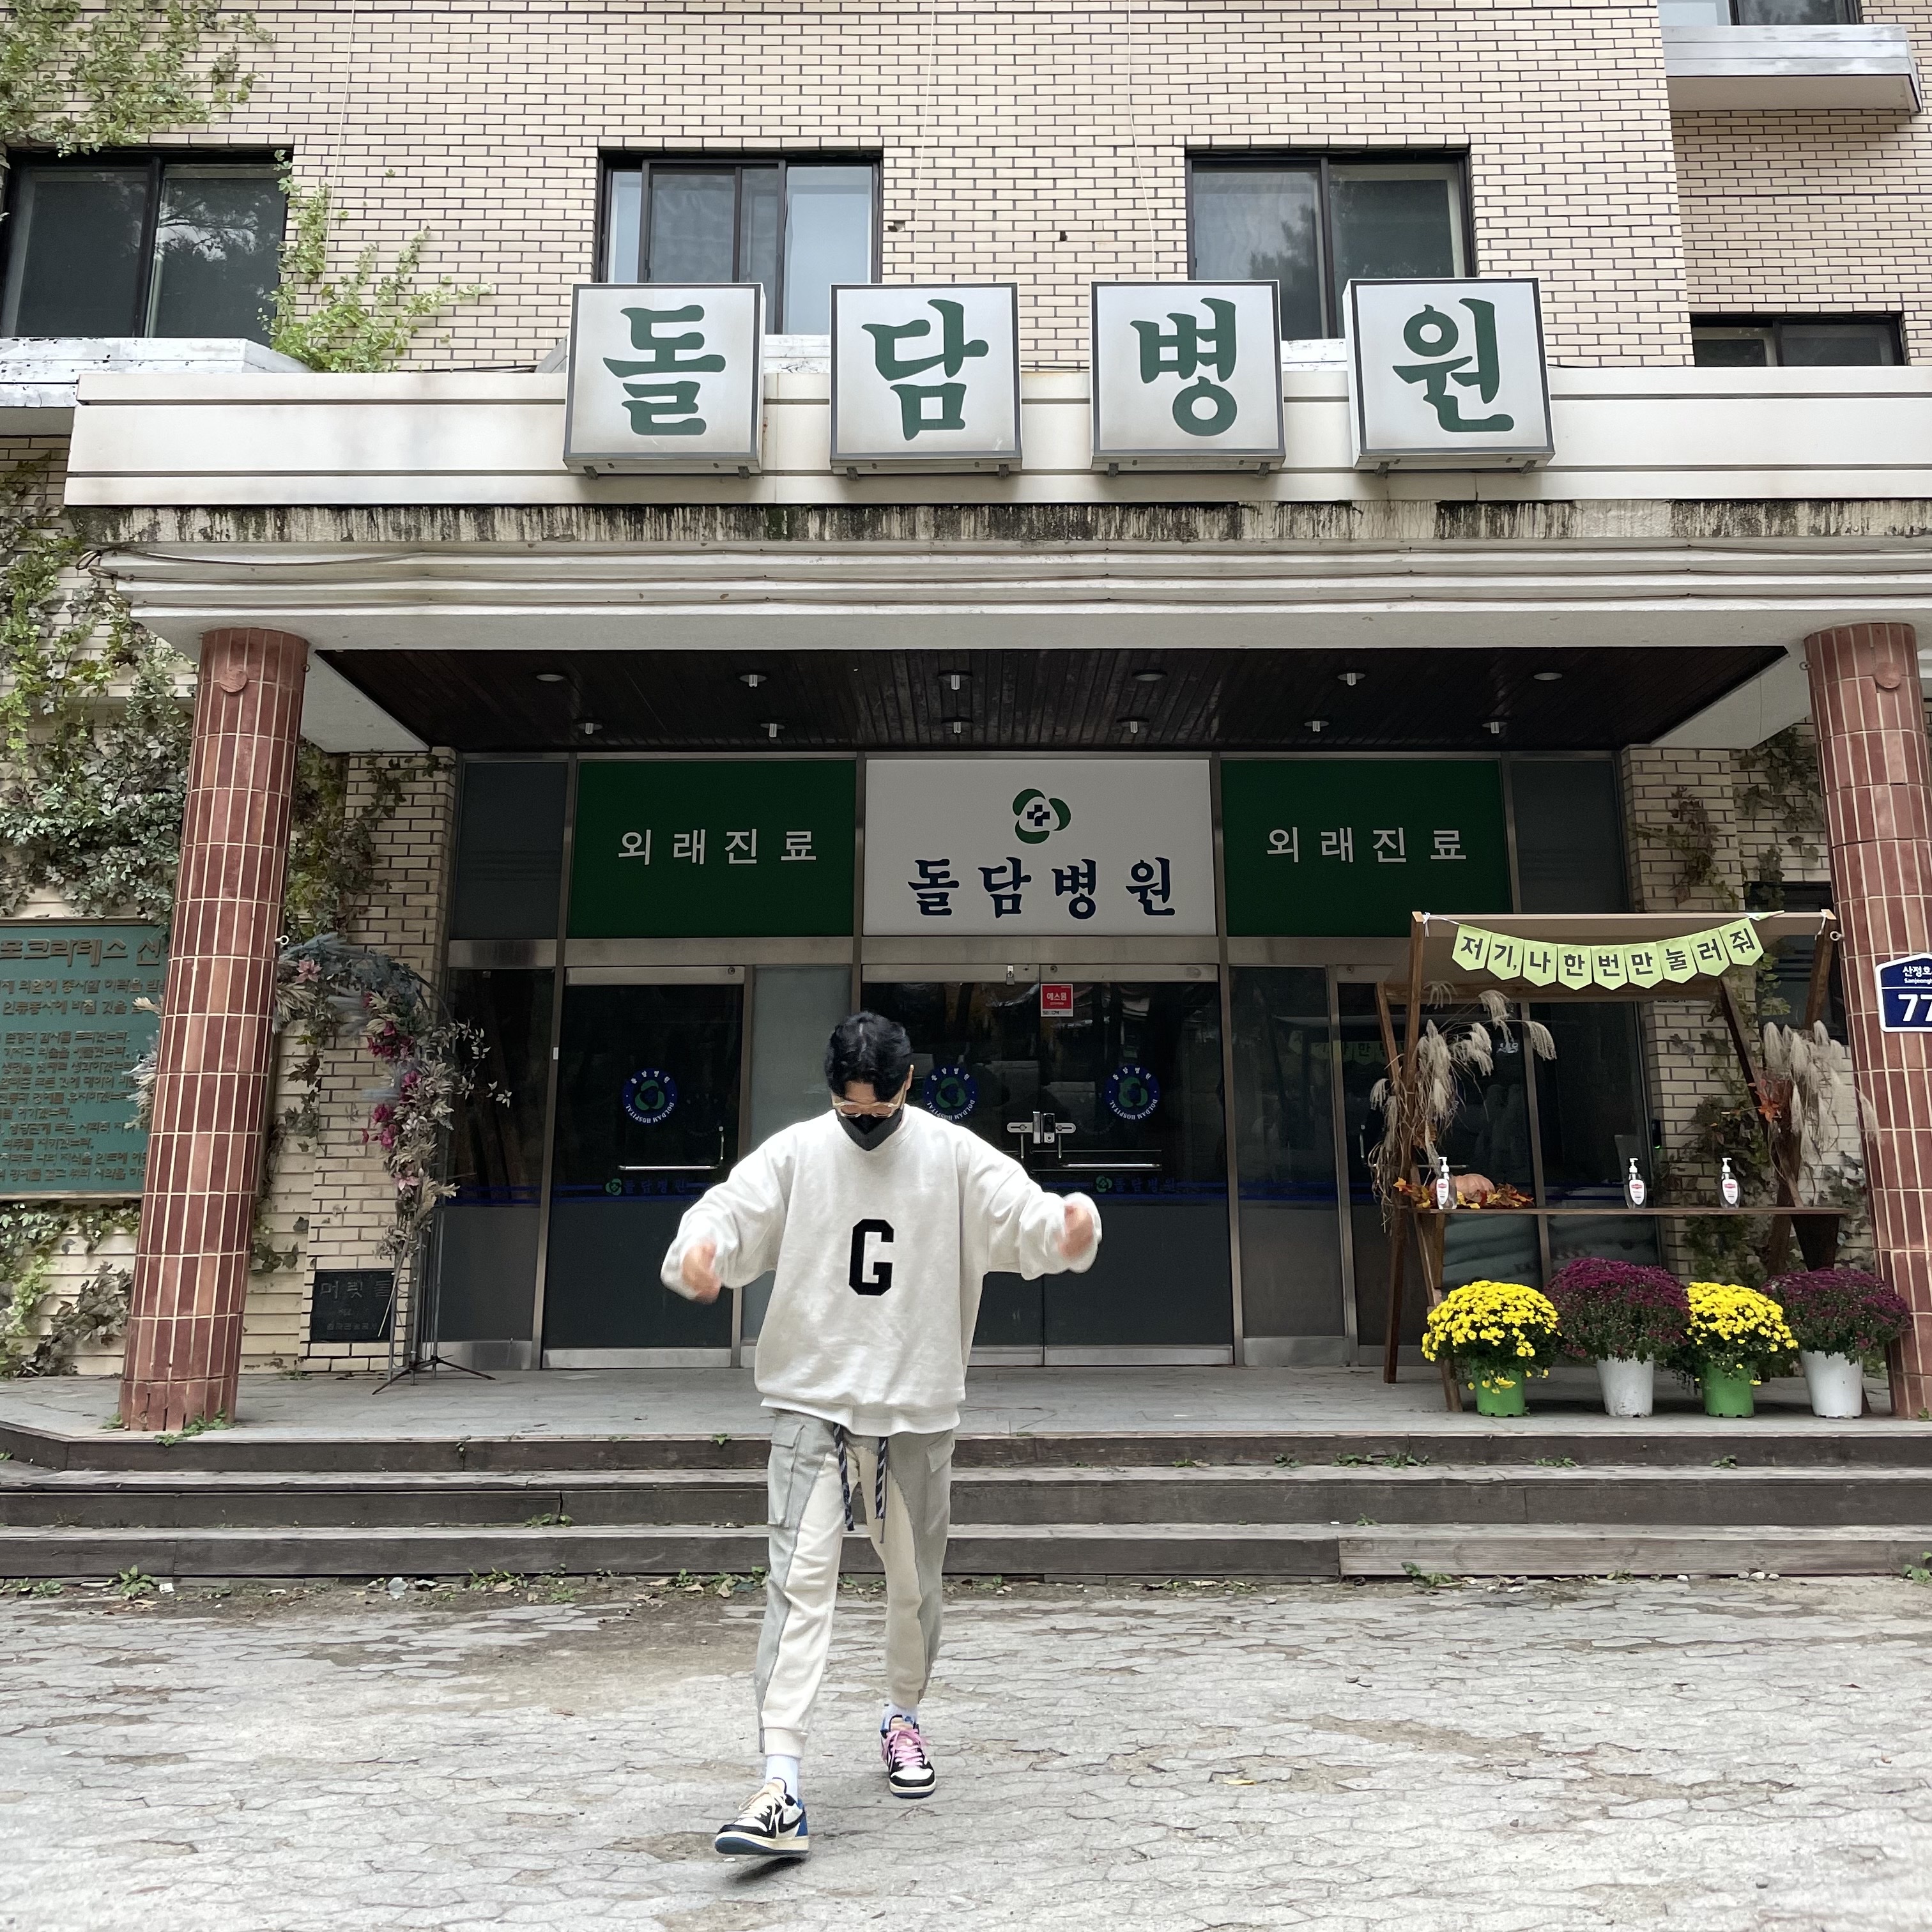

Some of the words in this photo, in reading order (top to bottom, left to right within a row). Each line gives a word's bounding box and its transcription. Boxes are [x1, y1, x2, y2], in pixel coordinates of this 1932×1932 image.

[618, 829, 816, 866] 외래진료
[1266, 827, 1466, 862] 외래진료
[908, 857, 1175, 919] 돌담병원
[136, 939, 169, 966] 선
[1902, 965, 1932, 977] 산정호
[1897, 994, 1932, 1022] 77
[626, 1103, 652, 1124] HOSPITAL
[652, 1102, 675, 1123] DOLDAM
[954, 1100, 976, 1120] DOLDAM
[1109, 1100, 1136, 1121] HOSPITAL
[1137, 1099, 1158, 1119] DOLDAM
[848, 1218, 894, 1296] G
